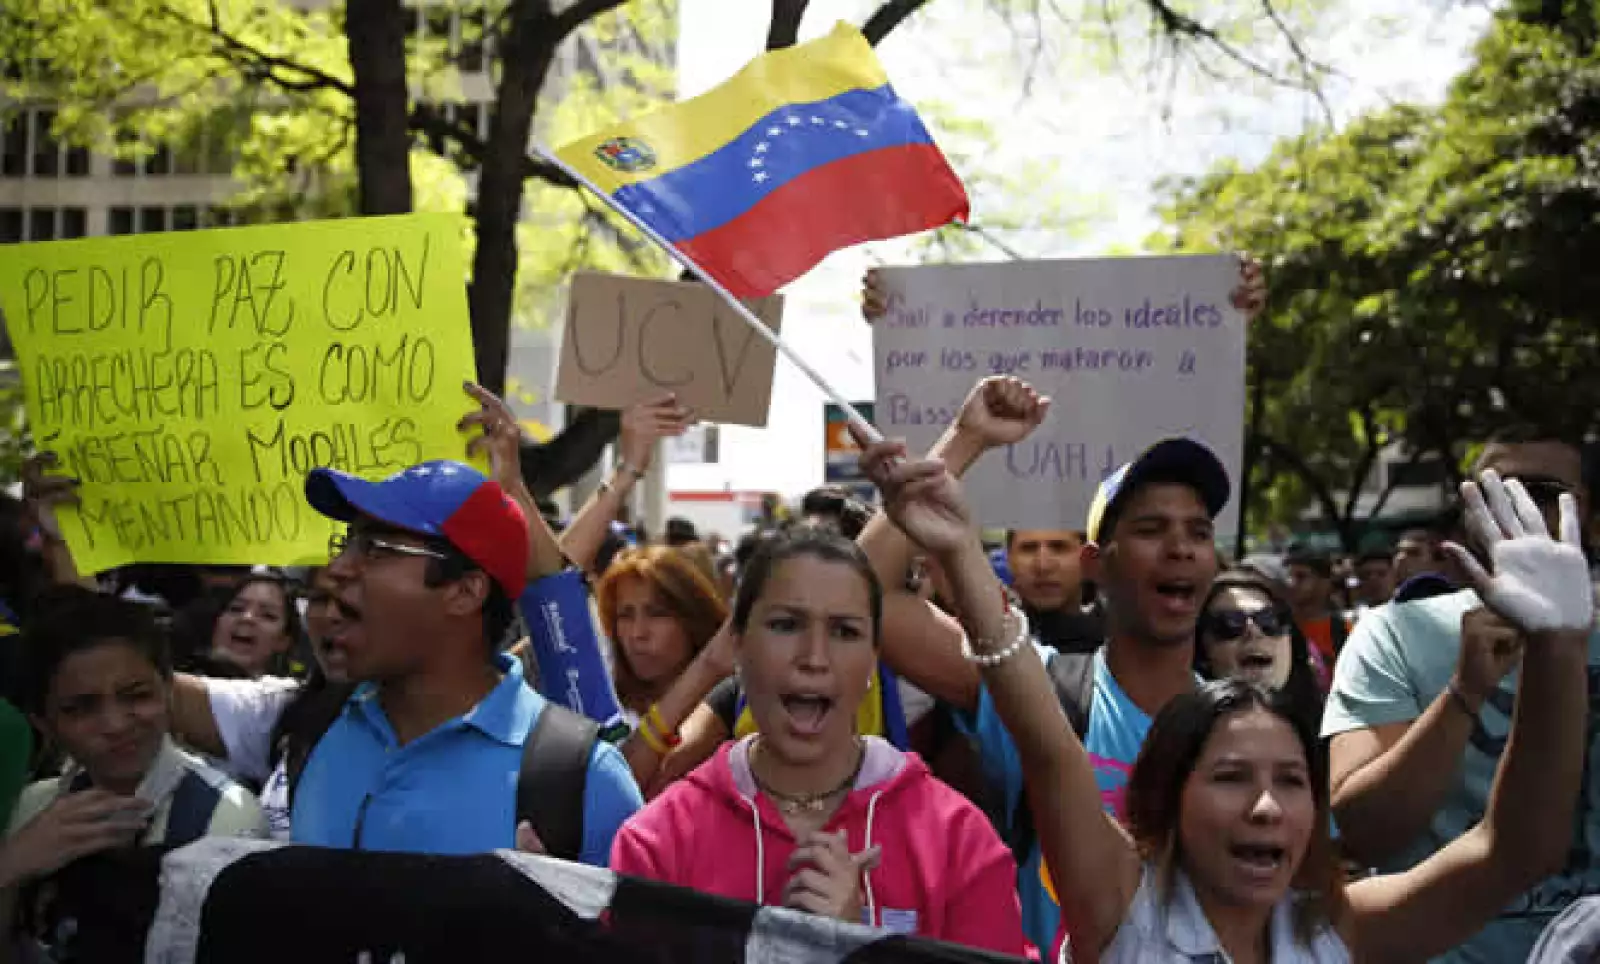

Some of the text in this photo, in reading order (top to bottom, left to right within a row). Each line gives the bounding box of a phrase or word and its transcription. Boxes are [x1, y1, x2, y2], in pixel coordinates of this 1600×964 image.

[22, 232, 430, 351] PEDIR PAZ CON
[1075, 297, 1113, 328] los
[1124, 294, 1223, 329] ideales
[240, 342, 296, 411] ES
[319, 332, 436, 407] COMO
[571, 290, 766, 399] UCV
[886, 350, 927, 375] por
[941, 348, 978, 372] los
[987, 347, 1032, 374] que
[247, 418, 422, 482] MODALES
[77, 482, 300, 550] MENTANDO
